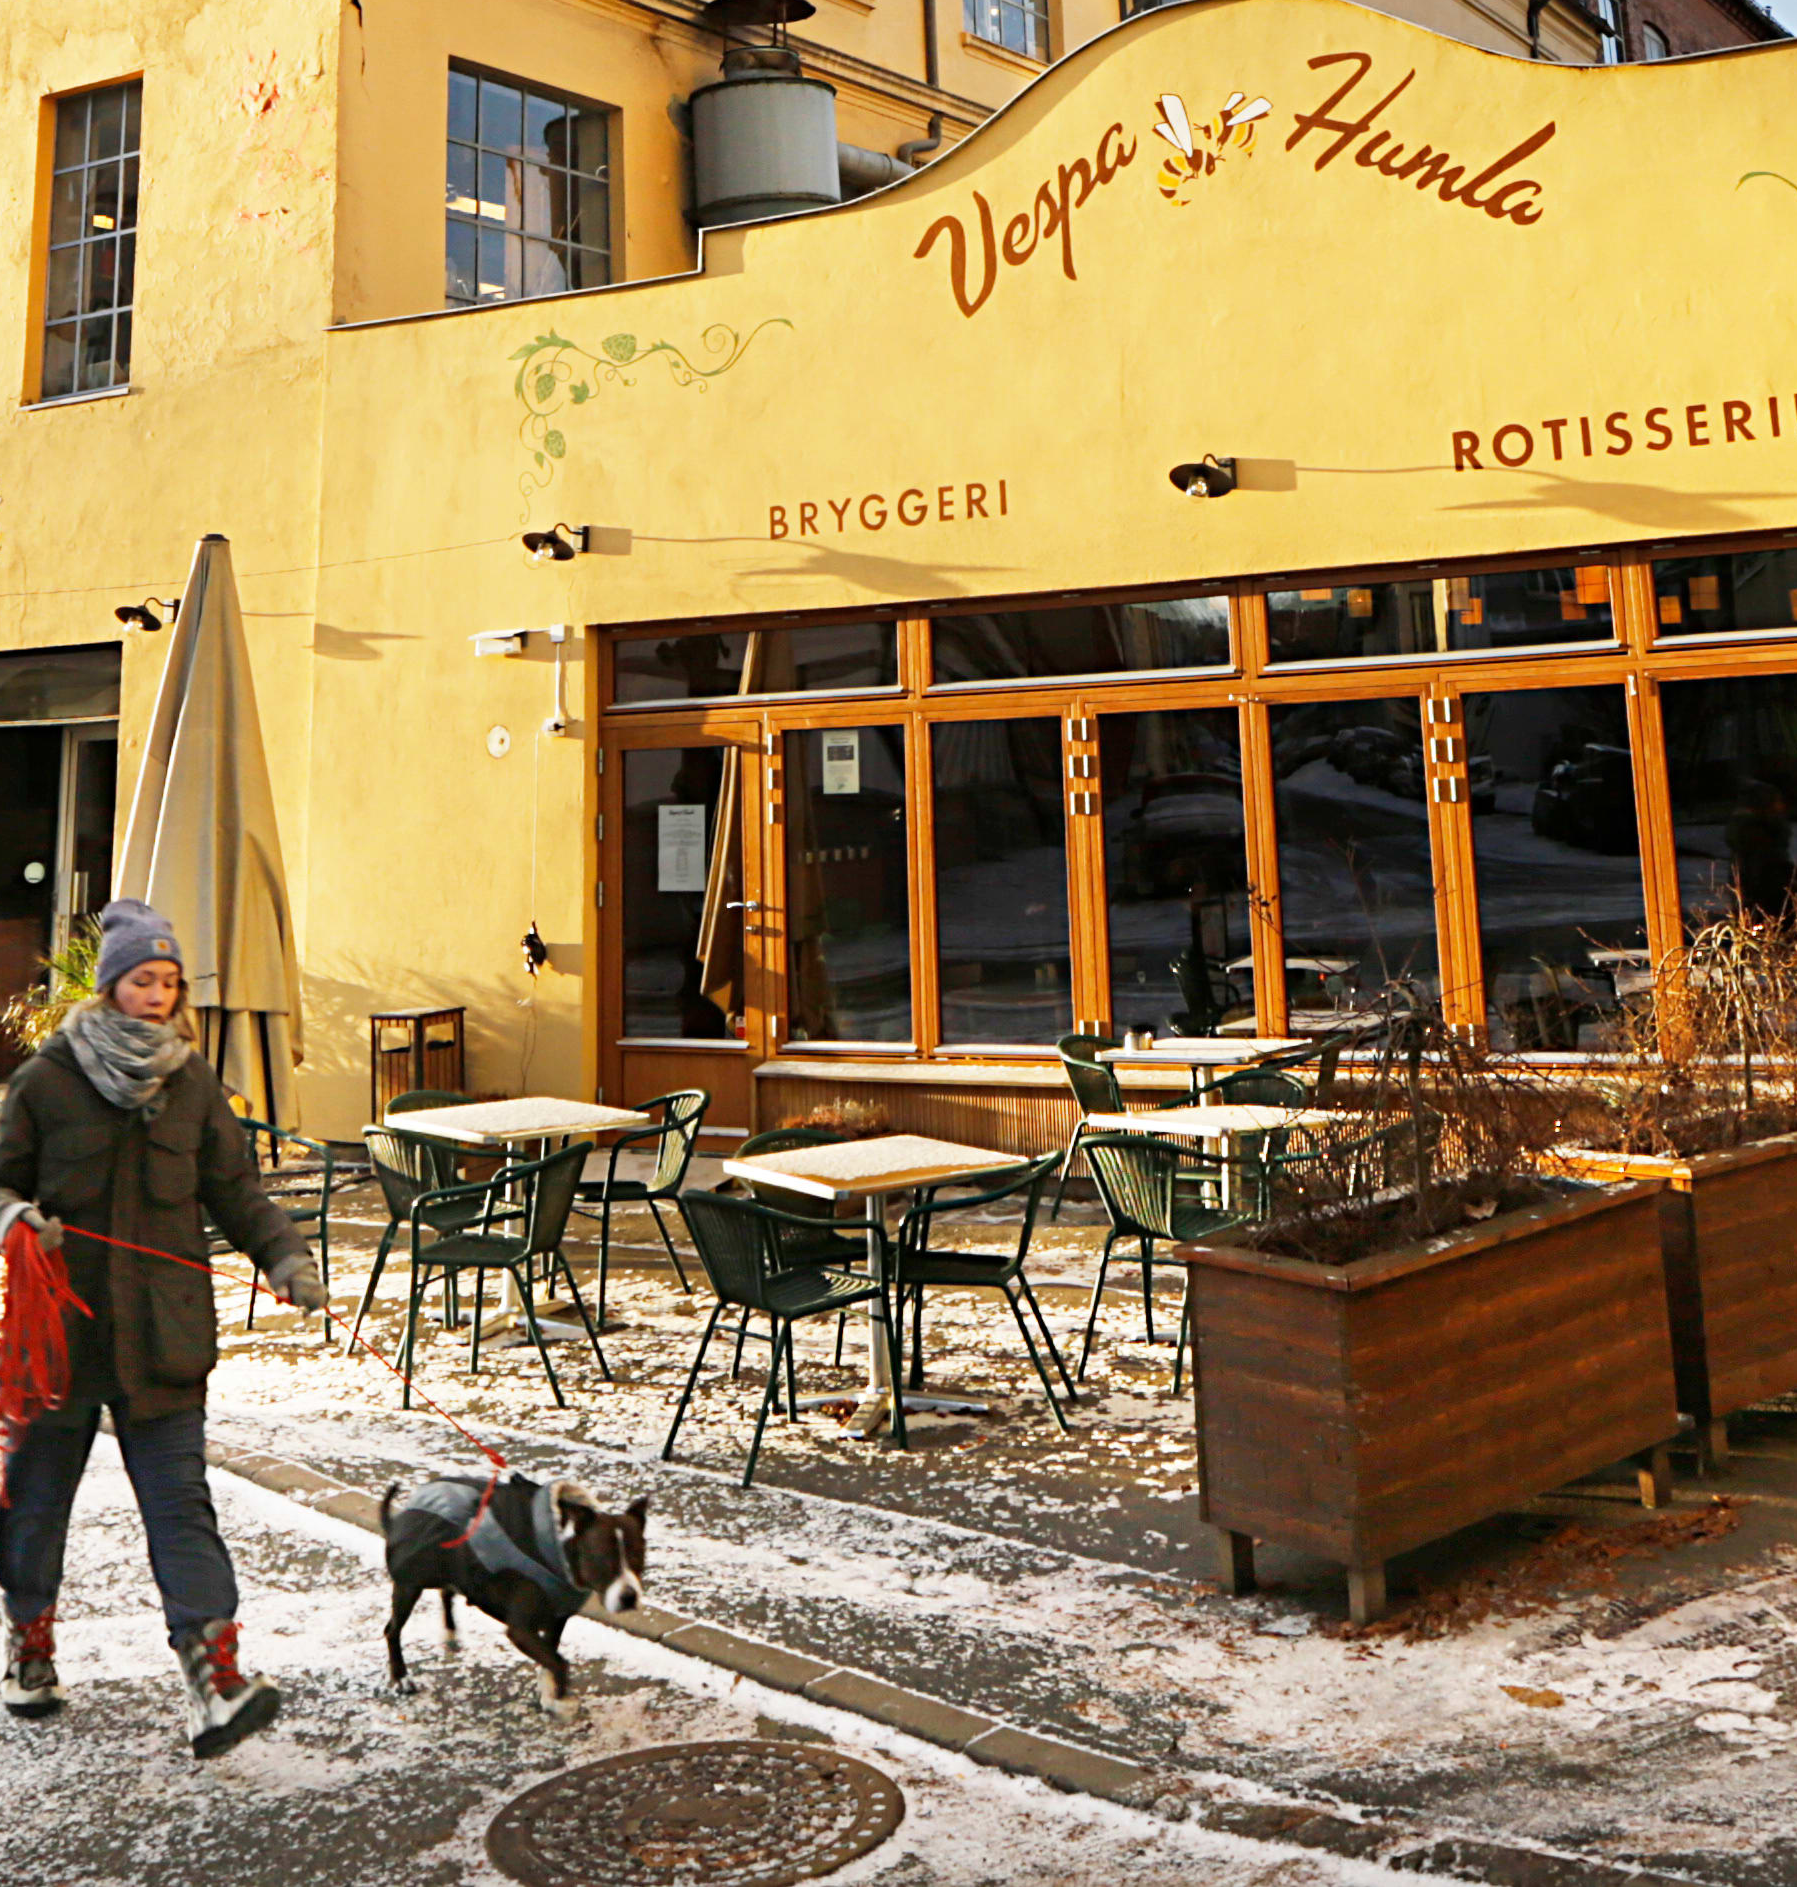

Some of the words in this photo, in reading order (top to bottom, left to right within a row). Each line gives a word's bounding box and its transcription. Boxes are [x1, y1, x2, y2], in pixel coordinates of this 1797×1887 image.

[913, 121, 1138, 318] Vespa
[1286, 51, 1556, 226] Humla
[769, 479, 1008, 540] BRYGGERI
